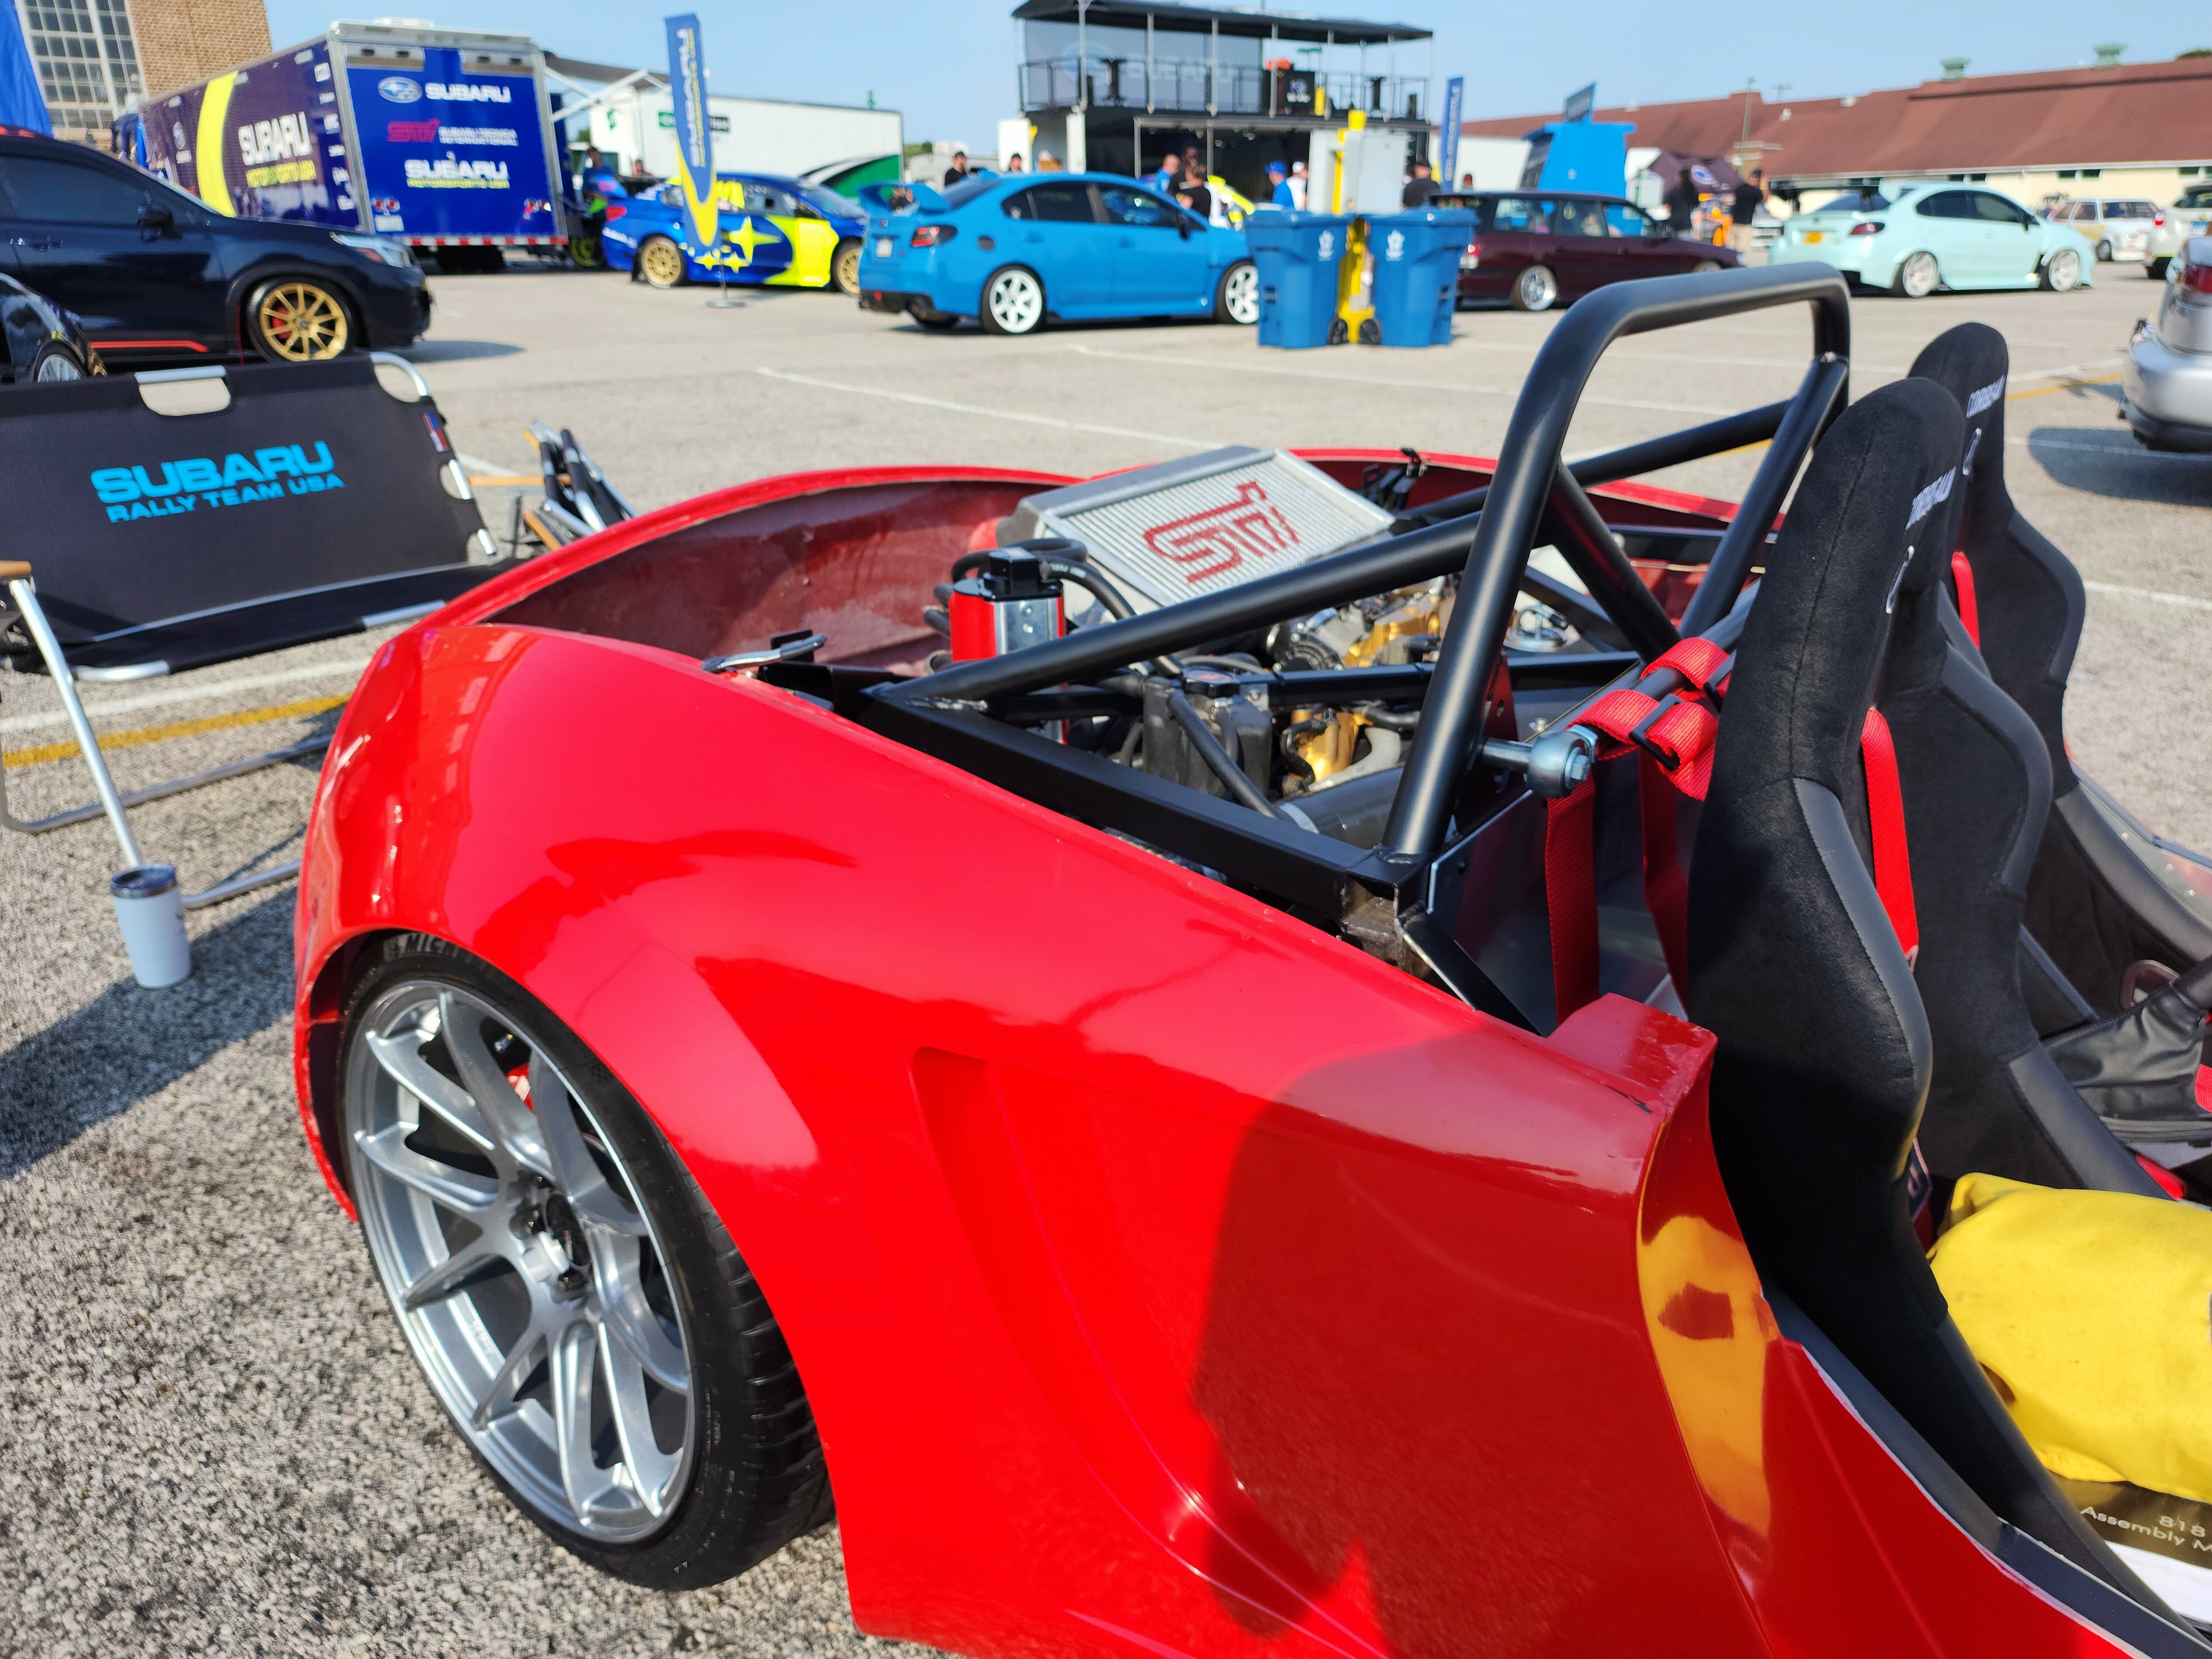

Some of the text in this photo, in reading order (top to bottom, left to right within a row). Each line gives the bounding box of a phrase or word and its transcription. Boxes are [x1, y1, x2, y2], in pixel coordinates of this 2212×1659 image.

[425, 83, 512, 103] SUBARU
[238, 111, 313, 166] SUBARU
[404, 159, 509, 179] SUBARU
[91, 440, 334, 503] SUBARU
[106, 473, 347, 523] RALLY TEAM USA
[2080, 1506, 2185, 1545] Assembly
[2159, 1516, 2206, 1537] 818
